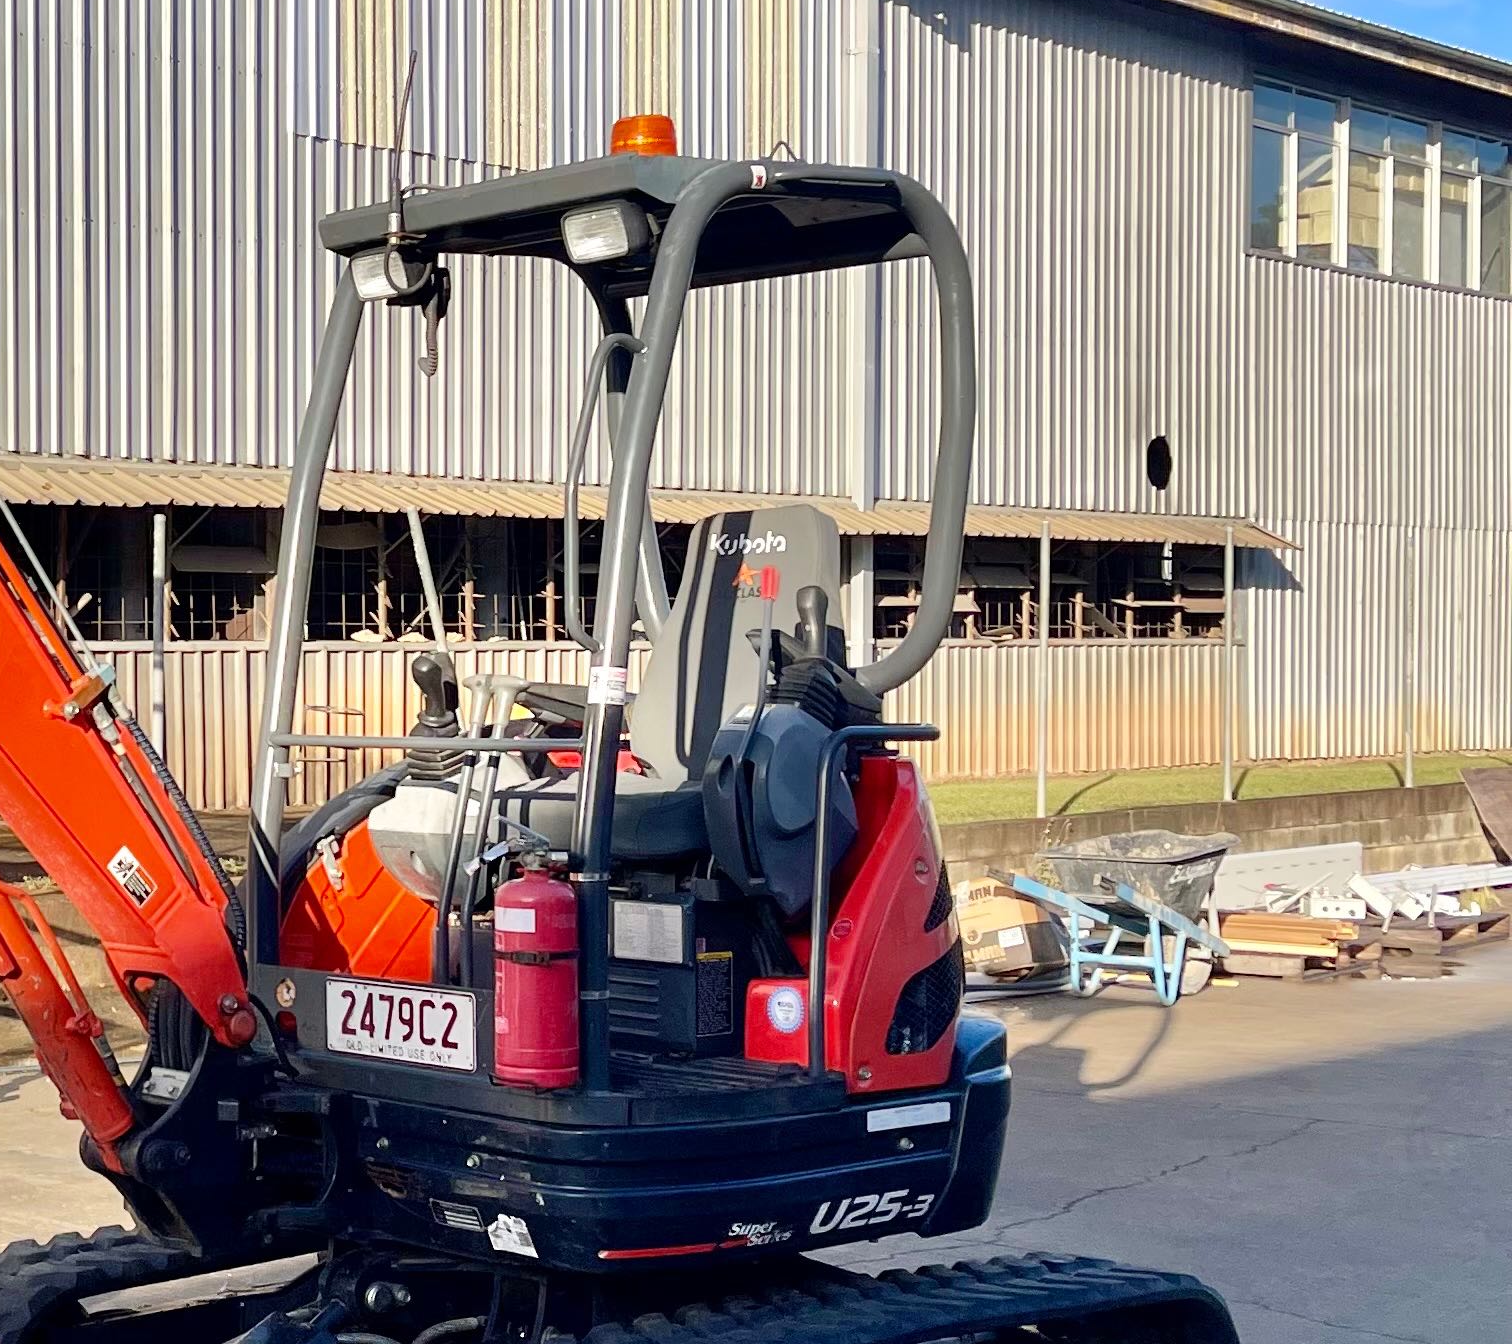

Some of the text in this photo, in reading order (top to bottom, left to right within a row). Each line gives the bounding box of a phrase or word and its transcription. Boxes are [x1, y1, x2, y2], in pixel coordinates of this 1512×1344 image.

[710, 530, 787, 555] Kubota
[341, 990, 459, 1050] 2479C2
[346, 1040, 362, 1052] QLD
[408, 1048, 425, 1061] USE
[430, 1051, 453, 1064] ONLY
[809, 1189, 935, 1235] U25-3
[728, 1221, 777, 1238] Super
